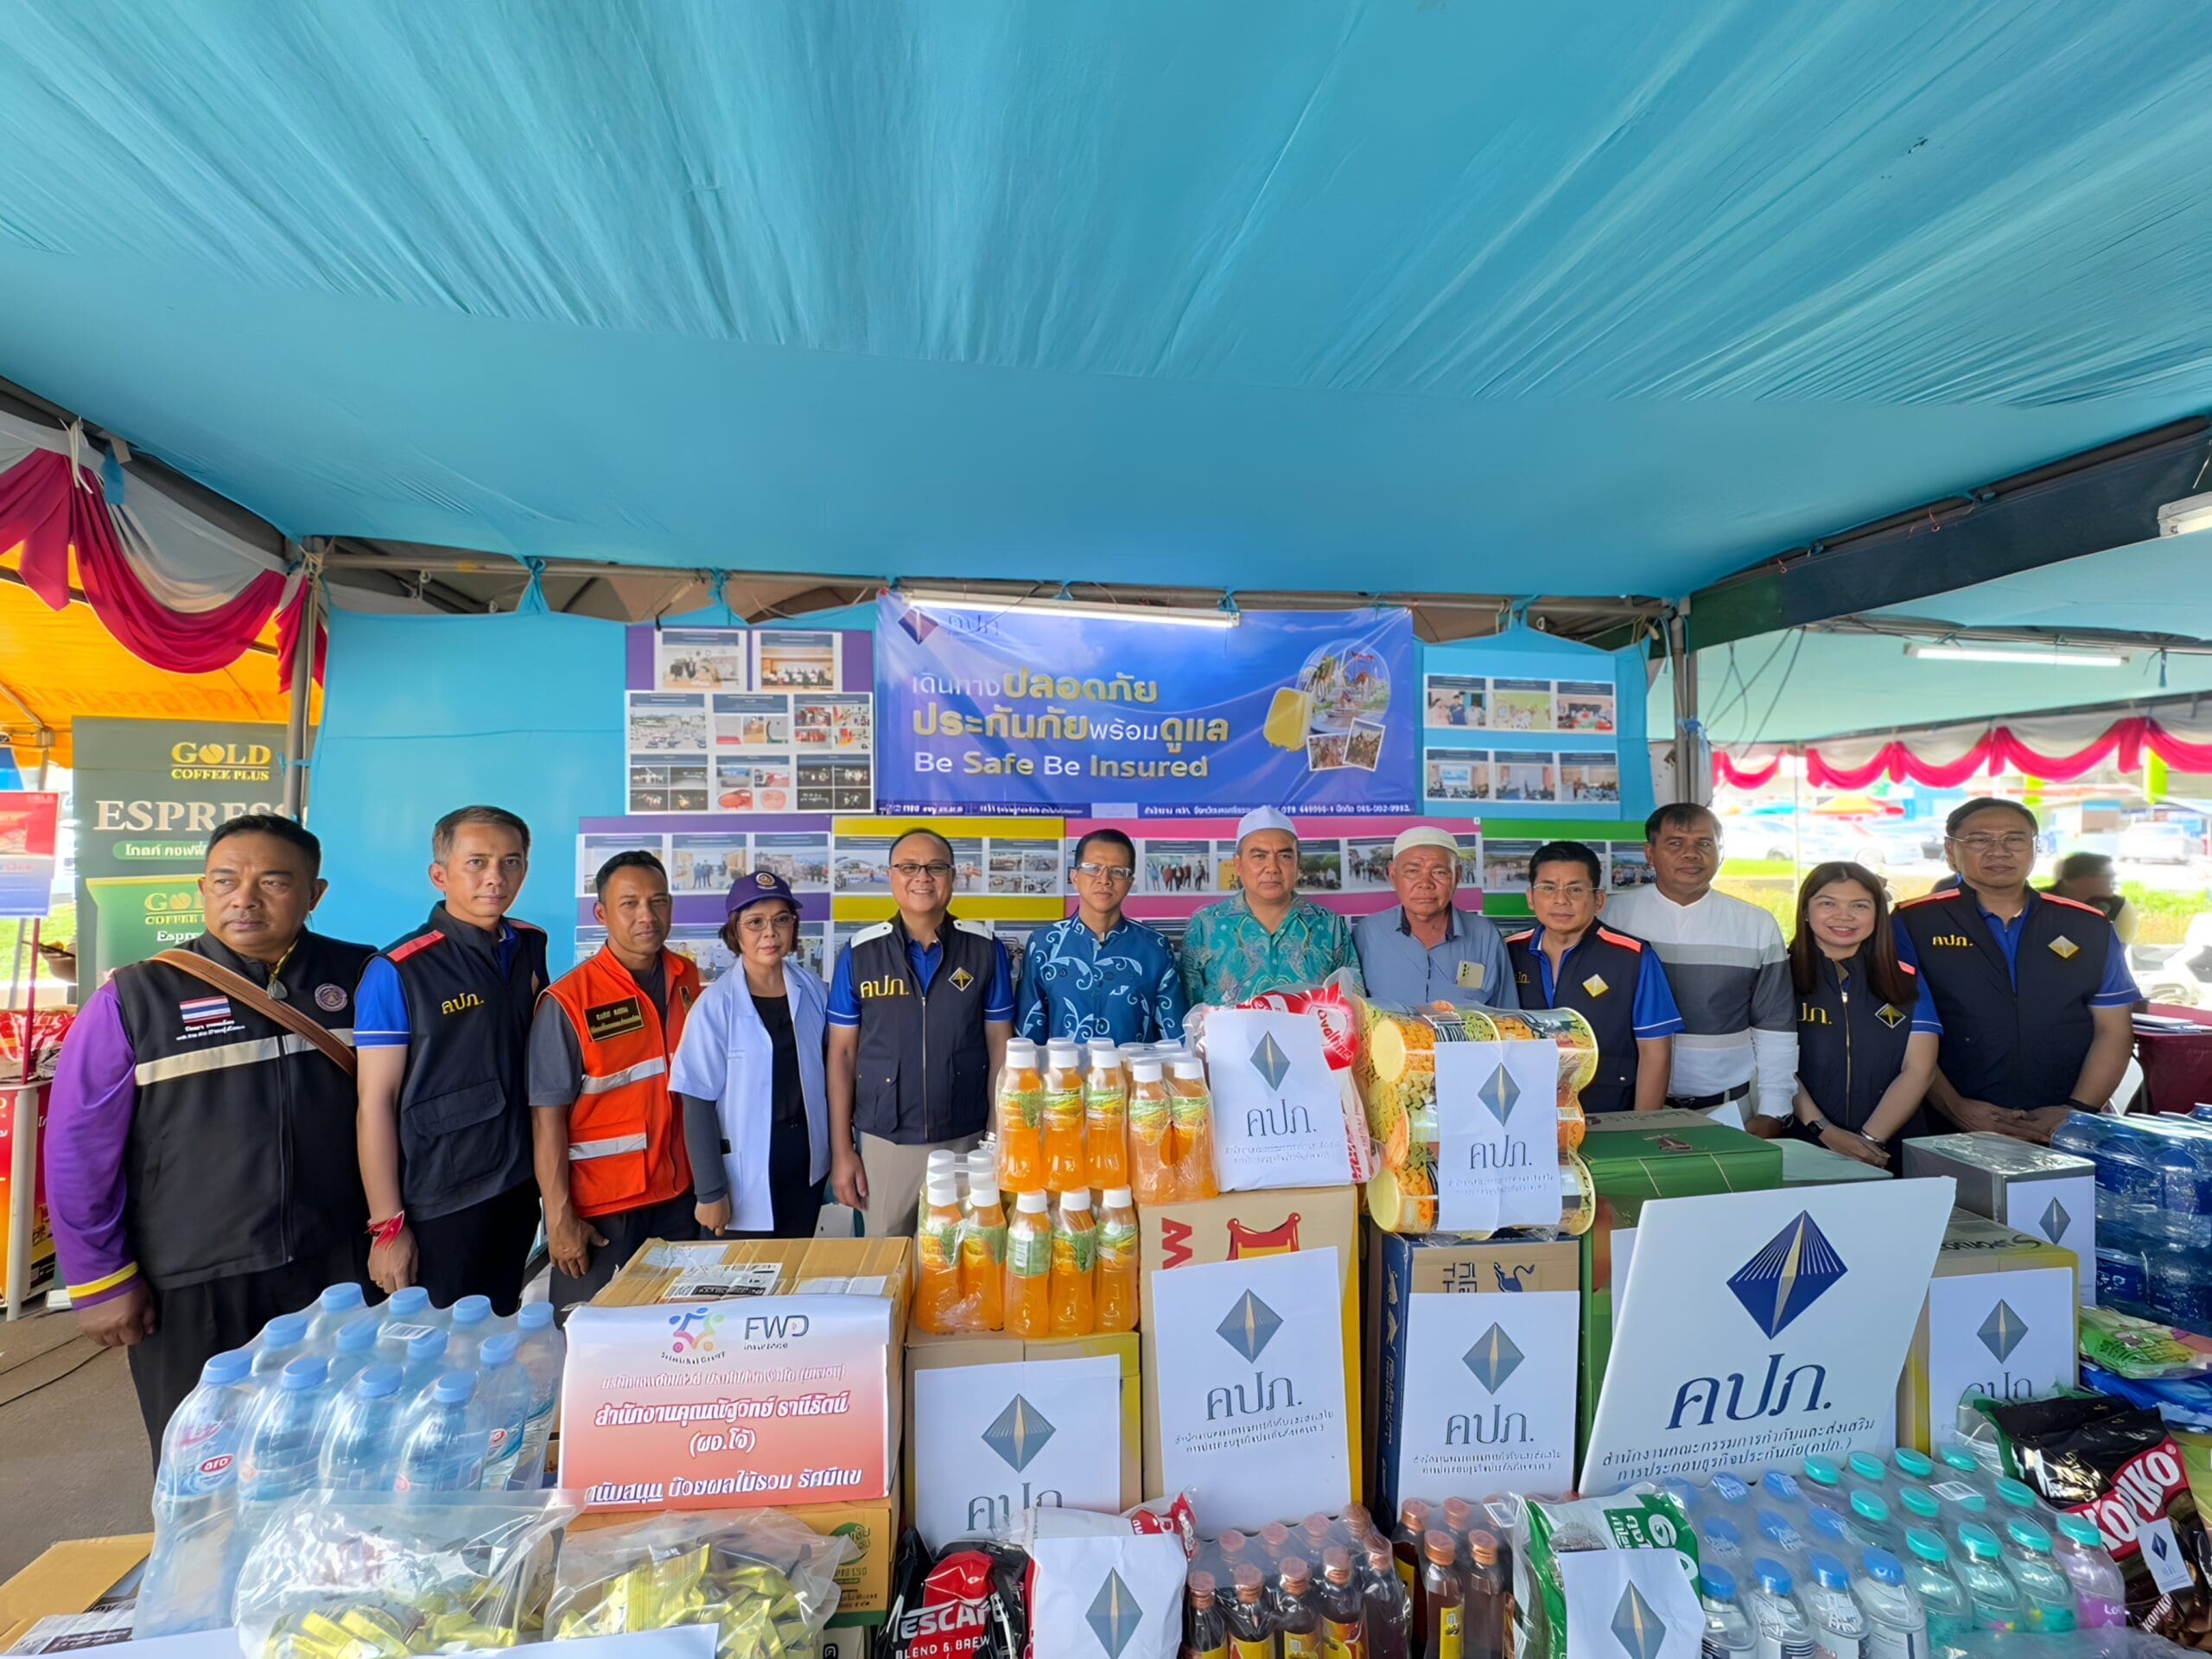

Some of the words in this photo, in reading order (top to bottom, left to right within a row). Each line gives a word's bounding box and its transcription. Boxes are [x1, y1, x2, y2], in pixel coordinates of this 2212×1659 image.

[912, 667, 1158, 703] เดินทางปลอดภัย
[912, 702, 1230, 754] ประกันภัยพร้อมดูแล
[171, 741, 271, 765] GOLD
[915, 751, 953, 772] Be
[963, 751, 1035, 775] Safe
[1044, 755, 1080, 776] Be
[1090, 754, 1209, 778] Insured
[171, 768, 231, 780] COFFEE
[233, 769, 270, 781] PLUS
[1932, 934, 1974, 947] คปภ.
[861, 975, 910, 999] คปภ.
[442, 993, 484, 1015] คปภ.
[1317, 1008, 1354, 1061] Ovaltine
[1247, 1098, 1317, 1137] คปภ.
[1469, 1134, 1533, 1169] คปภ.
[744, 1314, 810, 1340] FWD
[1206, 1371, 1302, 1421] คปภ.
[1665, 1353, 1832, 1430] คปภ.
[1445, 1404, 1534, 1445] คปภ.
[1602, 1417, 1875, 1466] สำนักงานคณะกรรมการกำกับและส่งเสริม
[203, 1458, 230, 1471] aro
[955, 1636, 990, 1650] BREW
